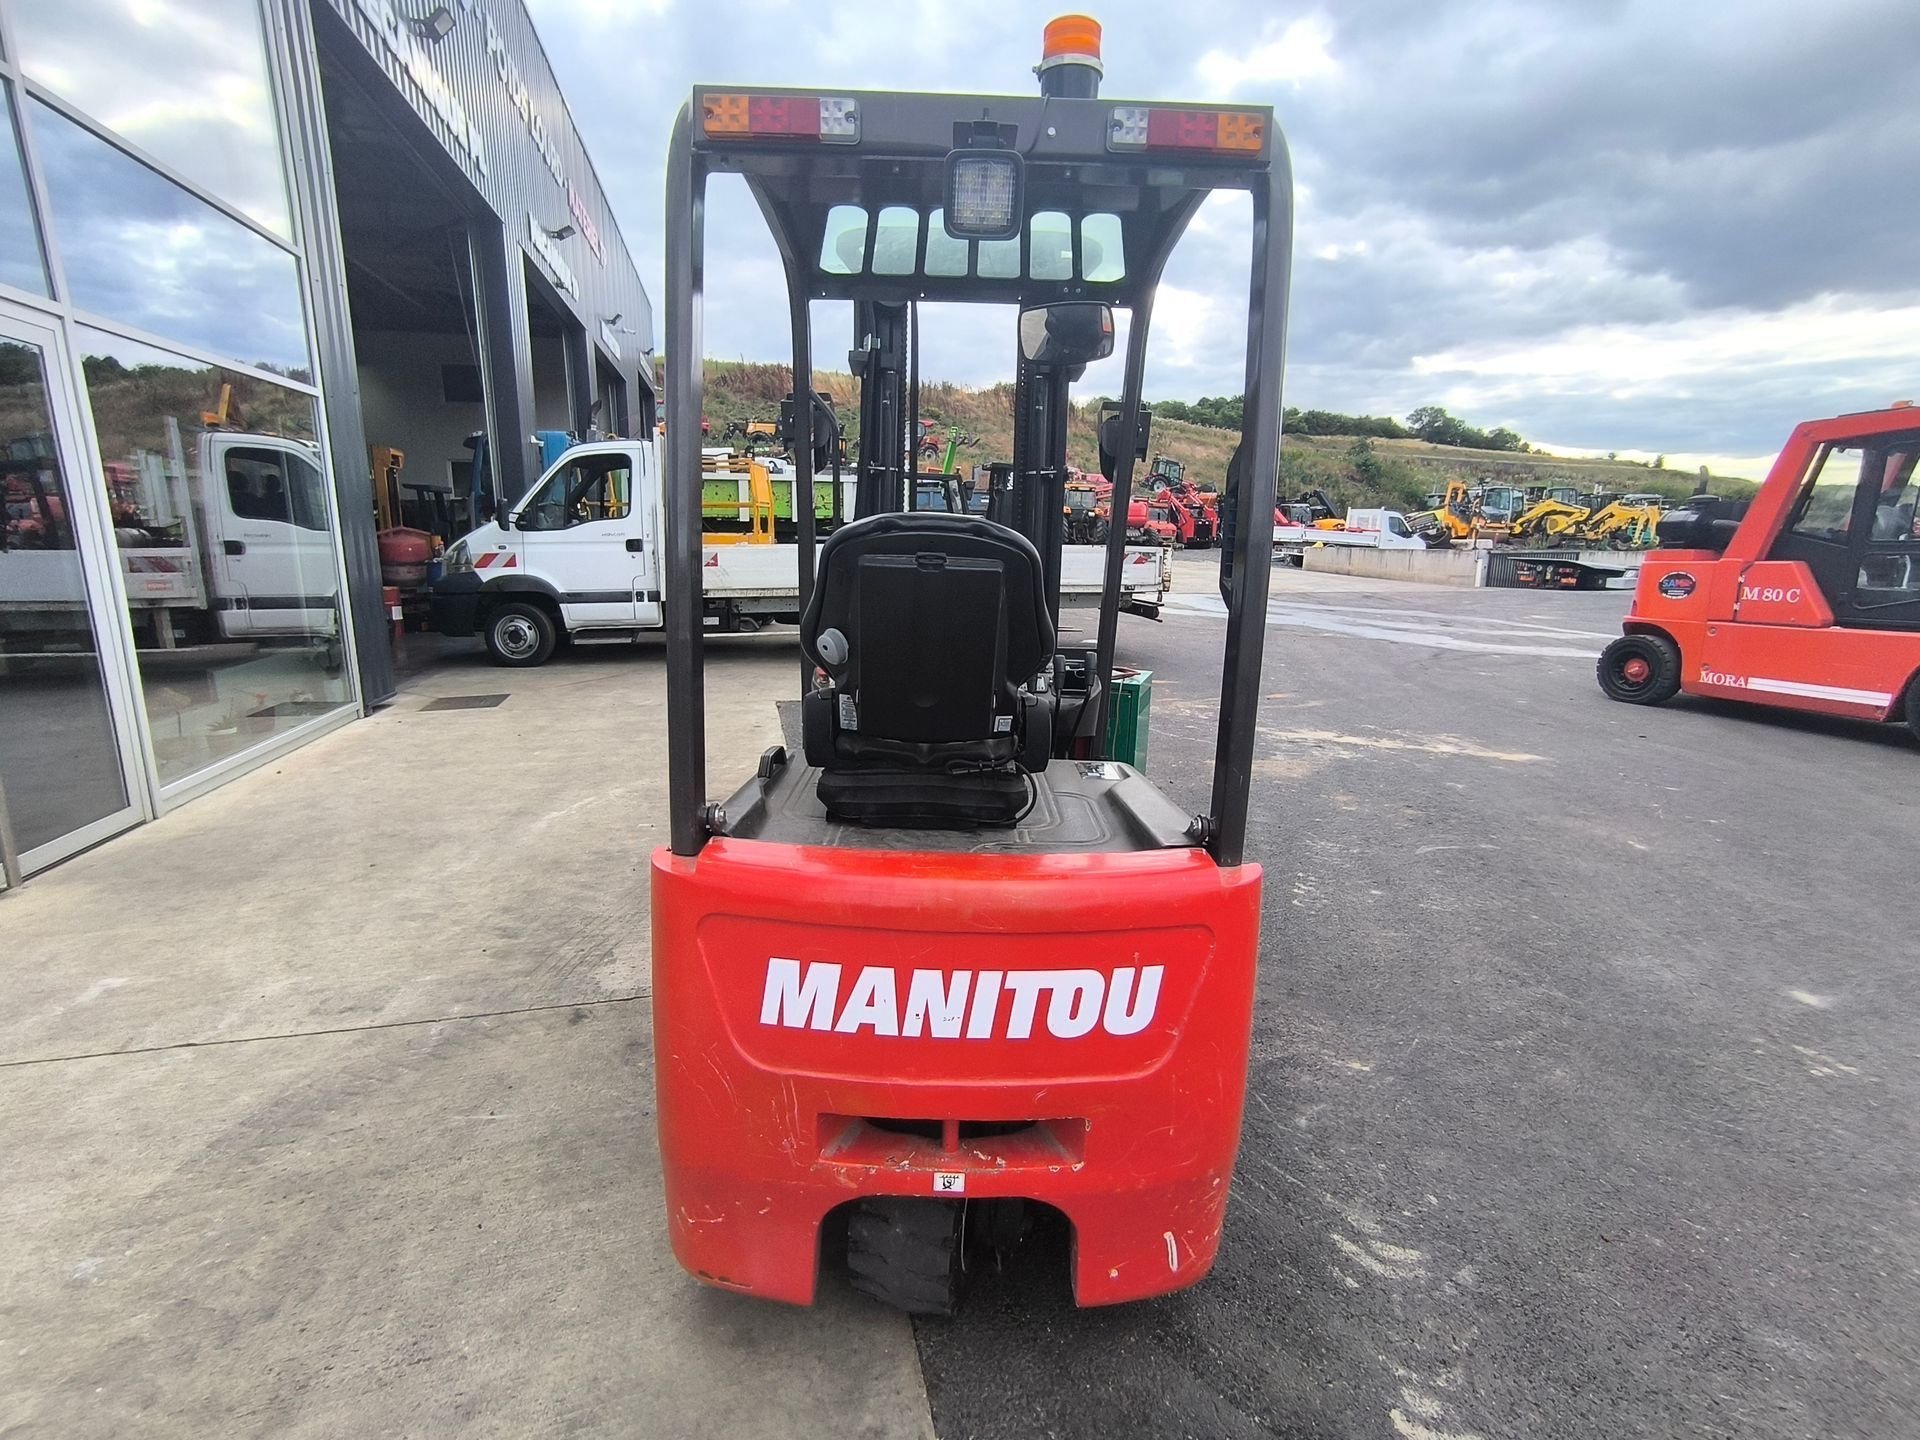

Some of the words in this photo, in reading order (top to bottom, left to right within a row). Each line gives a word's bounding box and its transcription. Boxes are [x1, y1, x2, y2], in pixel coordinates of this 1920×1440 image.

[1741, 586, 1761, 601] M
[1762, 587, 1784, 602] 80
[1786, 588, 1801, 603] C
[1698, 671, 1746, 688] MORA
[760, 957, 1165, 1039] MANITOU
